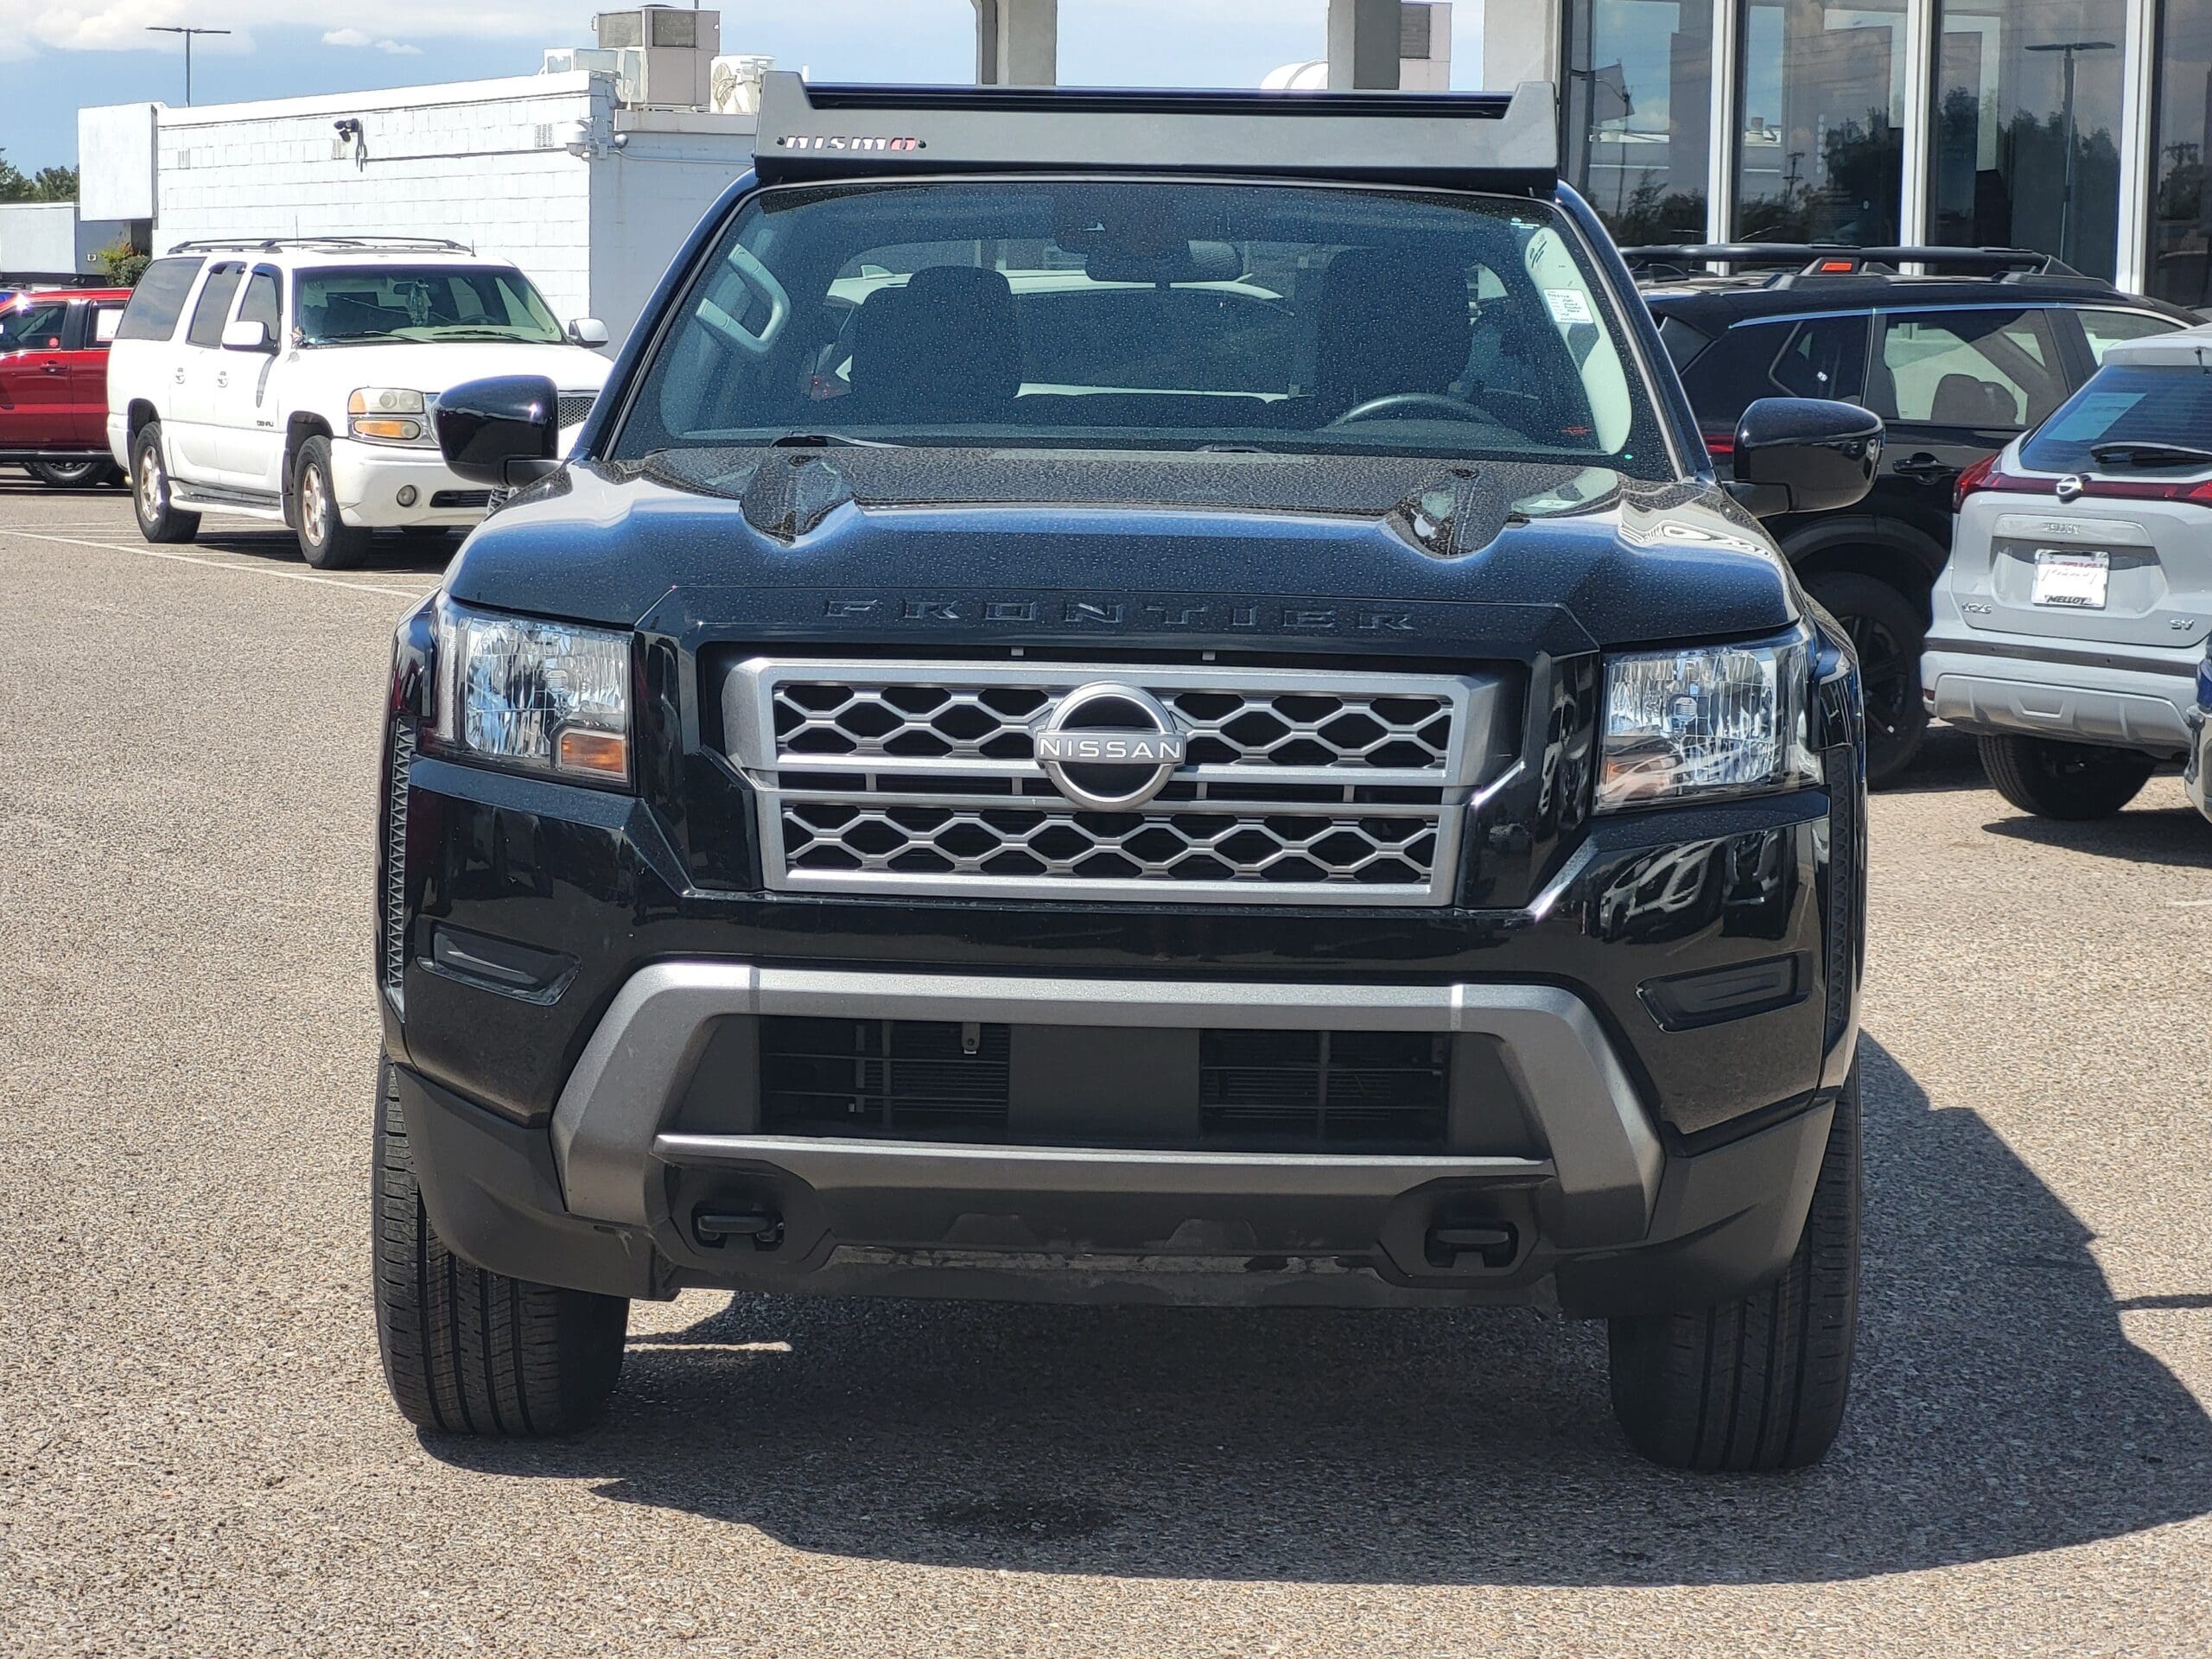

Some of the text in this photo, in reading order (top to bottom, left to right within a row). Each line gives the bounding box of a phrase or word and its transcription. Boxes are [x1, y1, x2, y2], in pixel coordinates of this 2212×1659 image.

[825, 598, 1415, 631] FRONTIER
[2170, 618, 2195, 631] SV
[1039, 739, 1180, 760] NISSAN
